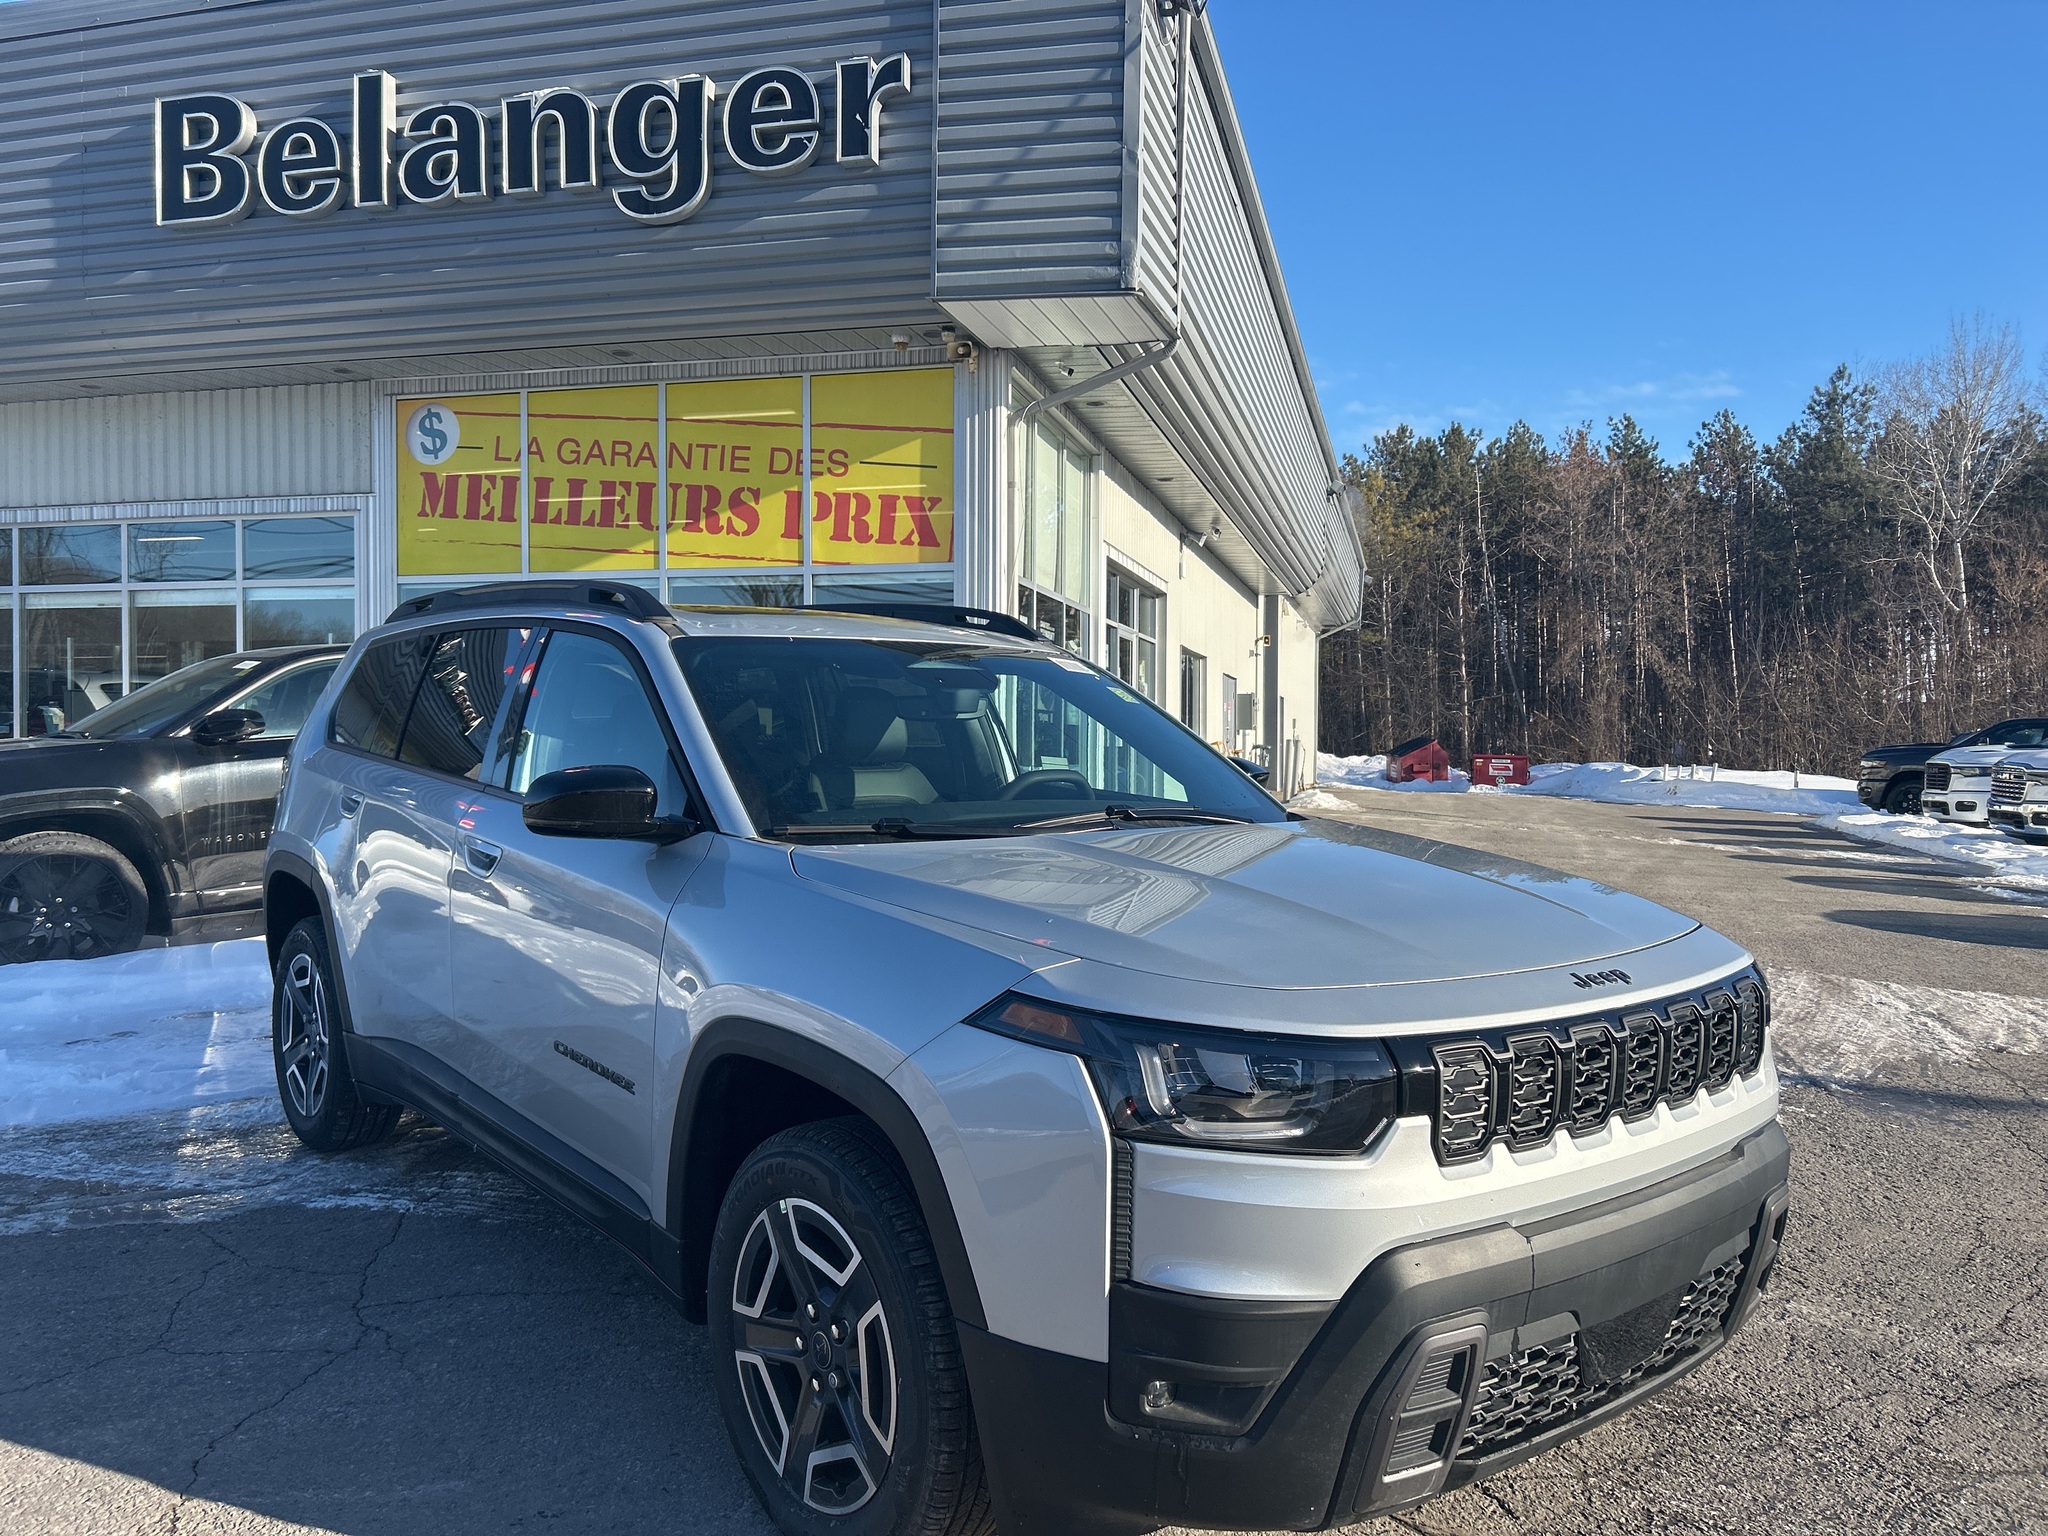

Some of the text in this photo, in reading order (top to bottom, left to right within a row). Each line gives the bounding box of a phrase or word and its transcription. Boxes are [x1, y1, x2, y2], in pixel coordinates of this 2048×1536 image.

[155, 52, 912, 226] Belanger
[418, 407, 448, 460] $
[494, 435, 849, 477] LA GARANTIE DES
[417, 471, 942, 547] MEILLEURS PRIX
[200, 830, 267, 845] WAGONE
[1569, 969, 1632, 990] Jeep
[553, 1039, 636, 1096] CHEROKEE
